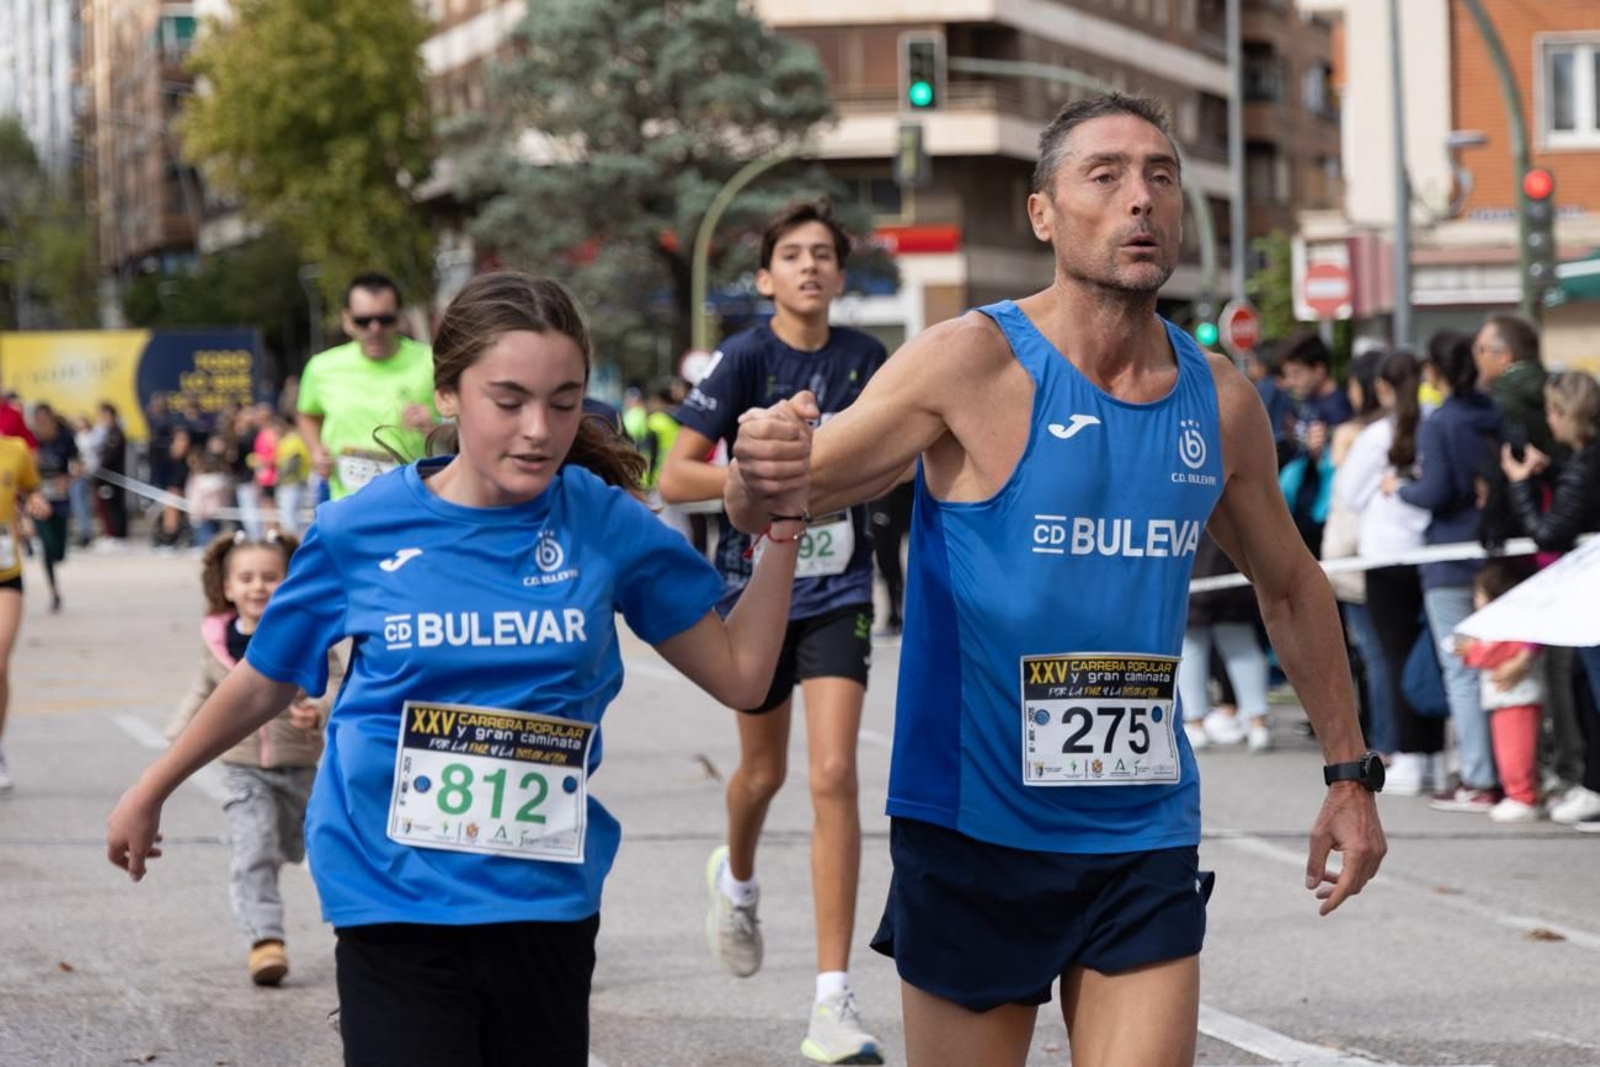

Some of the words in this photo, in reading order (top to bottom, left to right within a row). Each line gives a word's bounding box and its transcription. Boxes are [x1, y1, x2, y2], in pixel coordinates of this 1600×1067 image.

[798, 530, 836, 559] 92
[1033, 524, 1066, 545] CD
[1071, 517, 1202, 557] BULEVA
[384, 622, 412, 642] CD
[417, 608, 587, 647] BULEVAR
[1029, 661, 1068, 684] XXV
[1071, 661, 1126, 672] CARRERA
[1127, 661, 1172, 673] POPULAR
[1071, 672, 1080, 683] y
[1088, 672, 1120, 683] gran
[1125, 672, 1171, 683] caminata
[1068, 687, 1084, 696] LA
[411, 709, 456, 736] XXV
[458, 713, 524, 731] CARRERA
[525, 721, 585, 739] POPULAR
[456, 725, 466, 738] y
[475, 728, 514, 741] gran
[520, 733, 582, 750] caminata
[1061, 706, 1150, 755] 275
[450, 739, 468, 752] LA
[436, 763, 549, 825] 812
